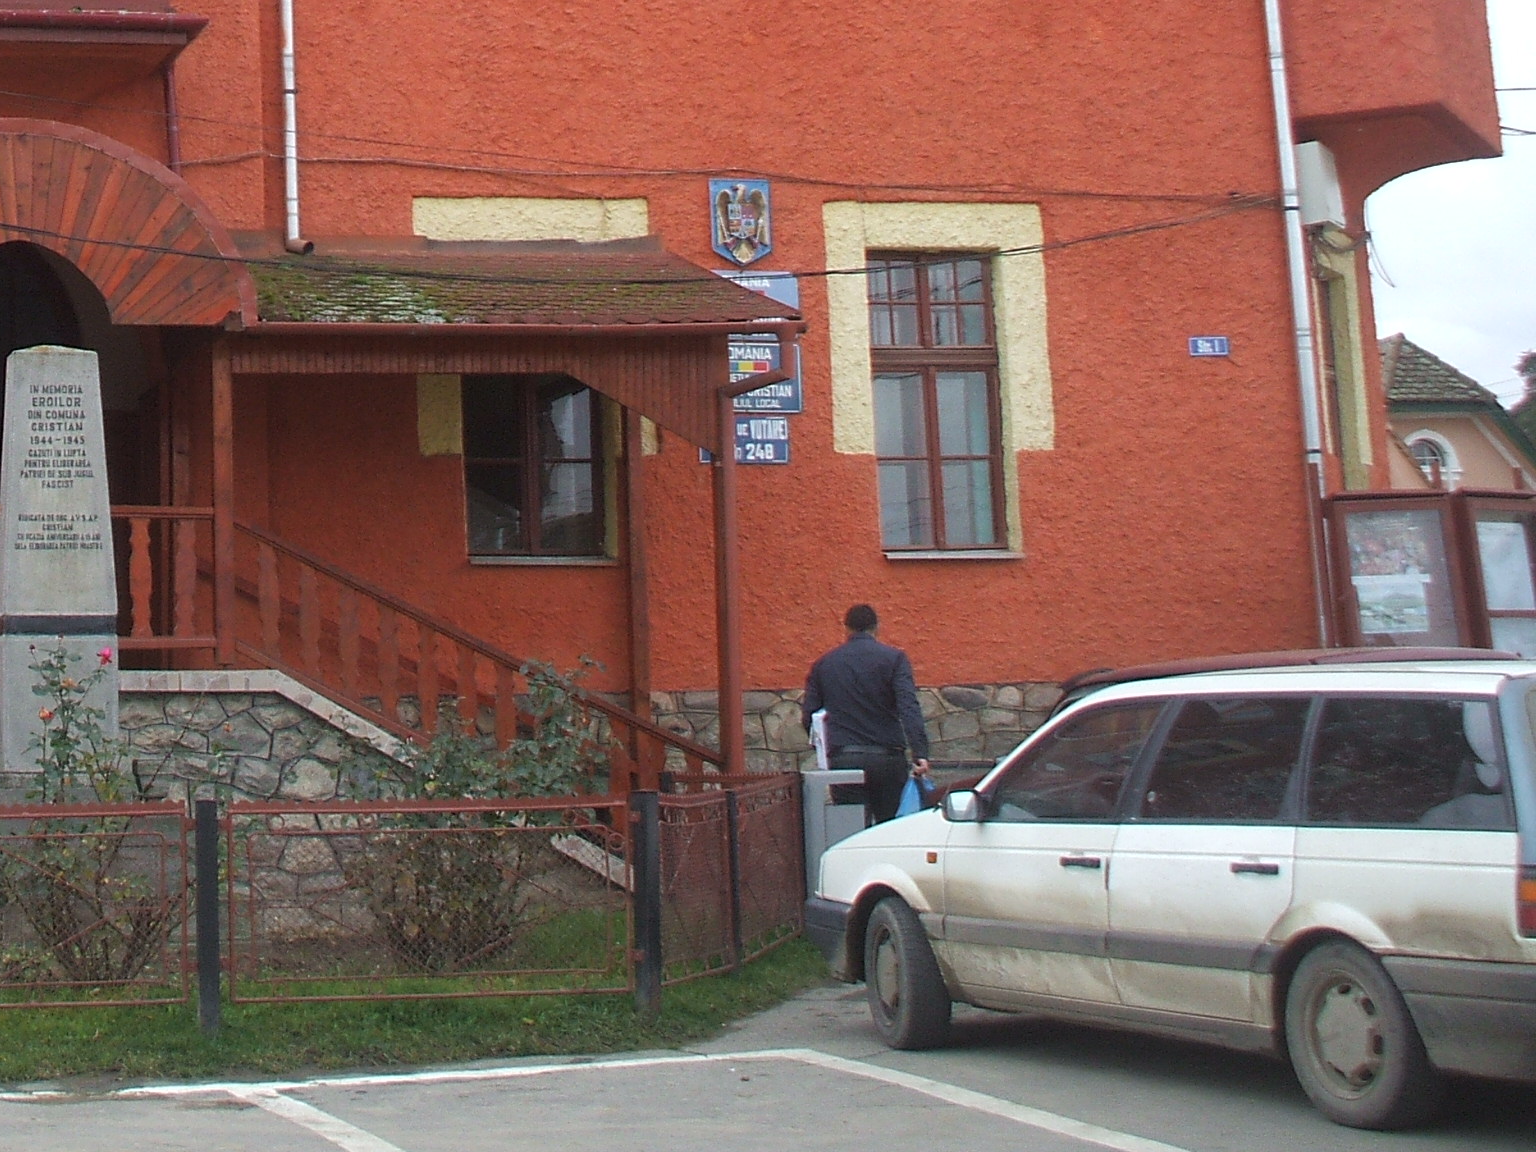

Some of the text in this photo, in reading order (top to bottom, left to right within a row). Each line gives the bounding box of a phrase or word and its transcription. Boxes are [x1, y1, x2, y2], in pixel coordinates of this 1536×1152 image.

[728, 346, 772, 360] OMÂNIA
[29, 385, 83, 394] IN MEMORIA
[31, 397, 81, 407] EROILOR
[28, 410, 86, 419] DIN COMUNA
[31, 422, 83, 431] CRISTIAN
